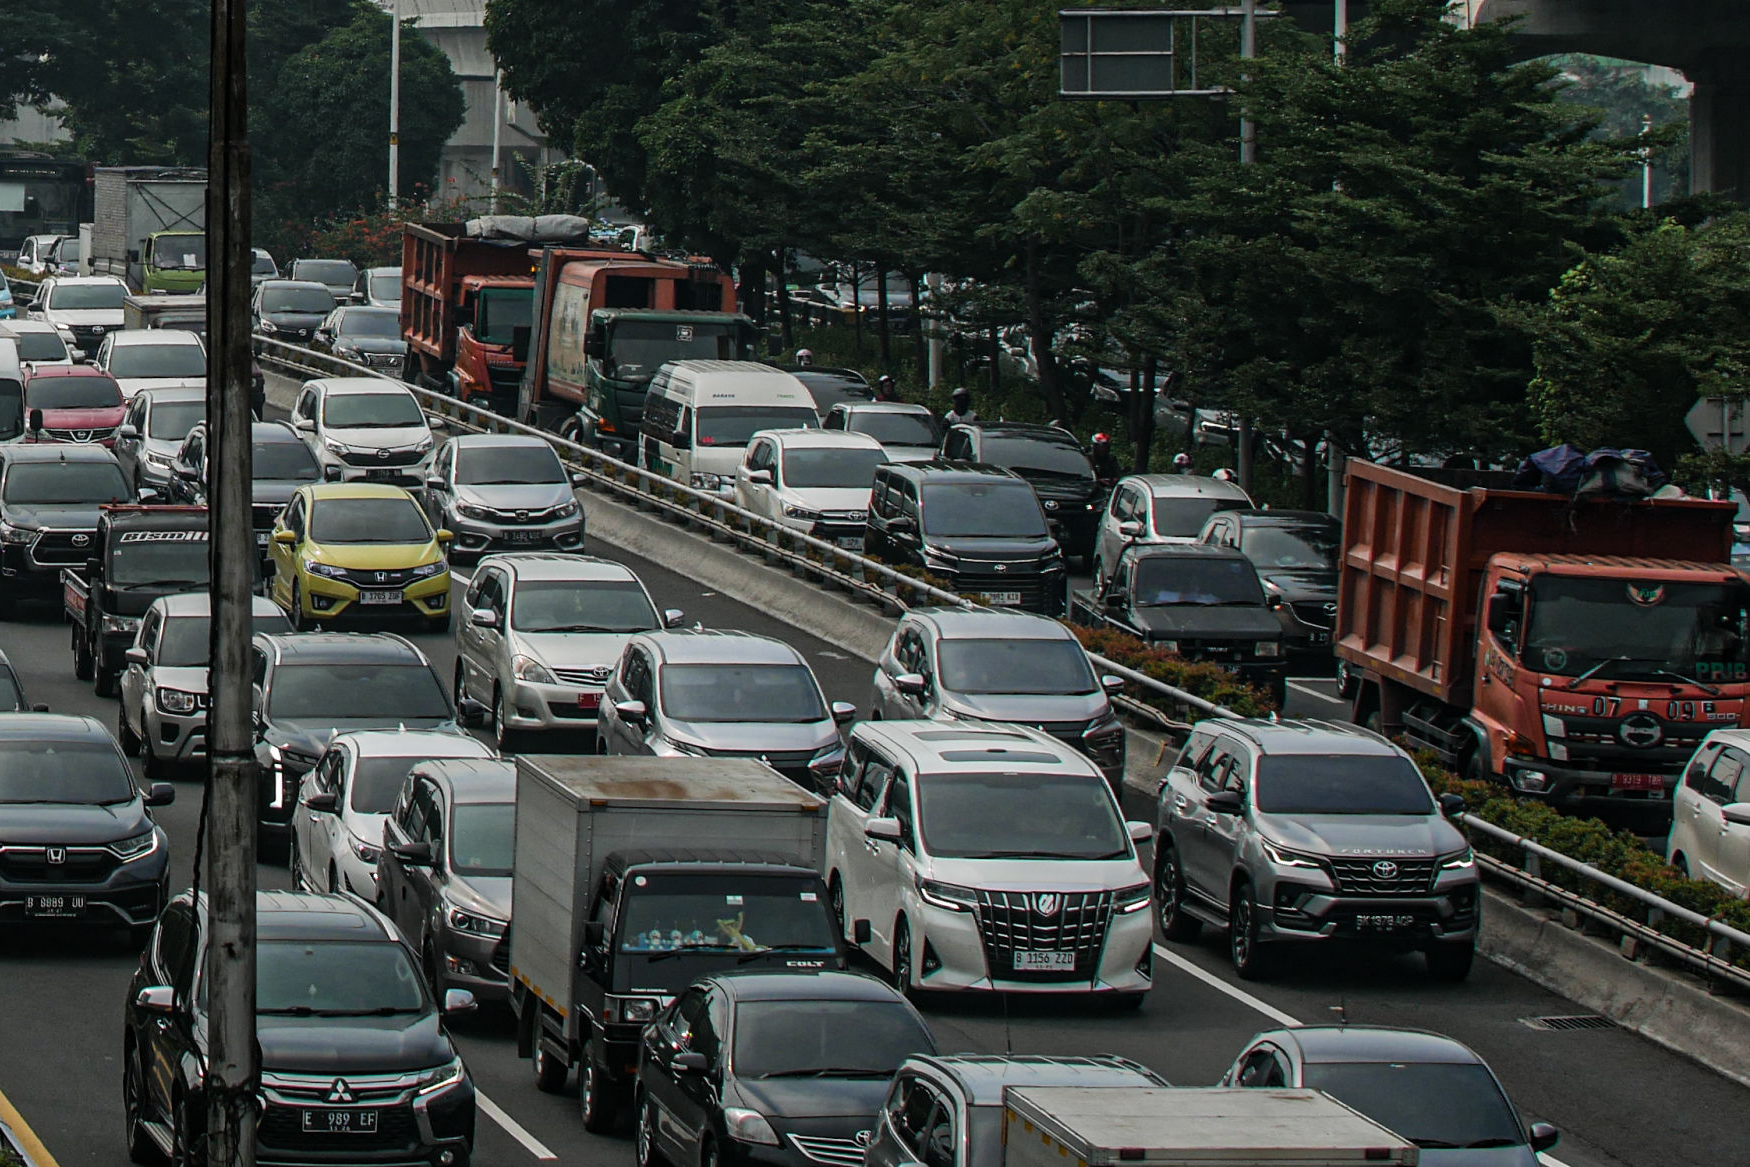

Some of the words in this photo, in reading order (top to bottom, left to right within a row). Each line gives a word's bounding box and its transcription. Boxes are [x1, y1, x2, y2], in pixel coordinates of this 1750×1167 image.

[1593, 696, 1621, 718] 07
[1668, 700, 1697, 720] 09
[27, 897, 34, 908] B
[72, 897, 84, 908] UU
[1016, 952, 1022, 963] B
[1027, 952, 1050, 964] 1156
[305, 1112, 312, 1125] E
[328, 1113, 350, 1126] 989
[360, 1113, 375, 1126] EF
